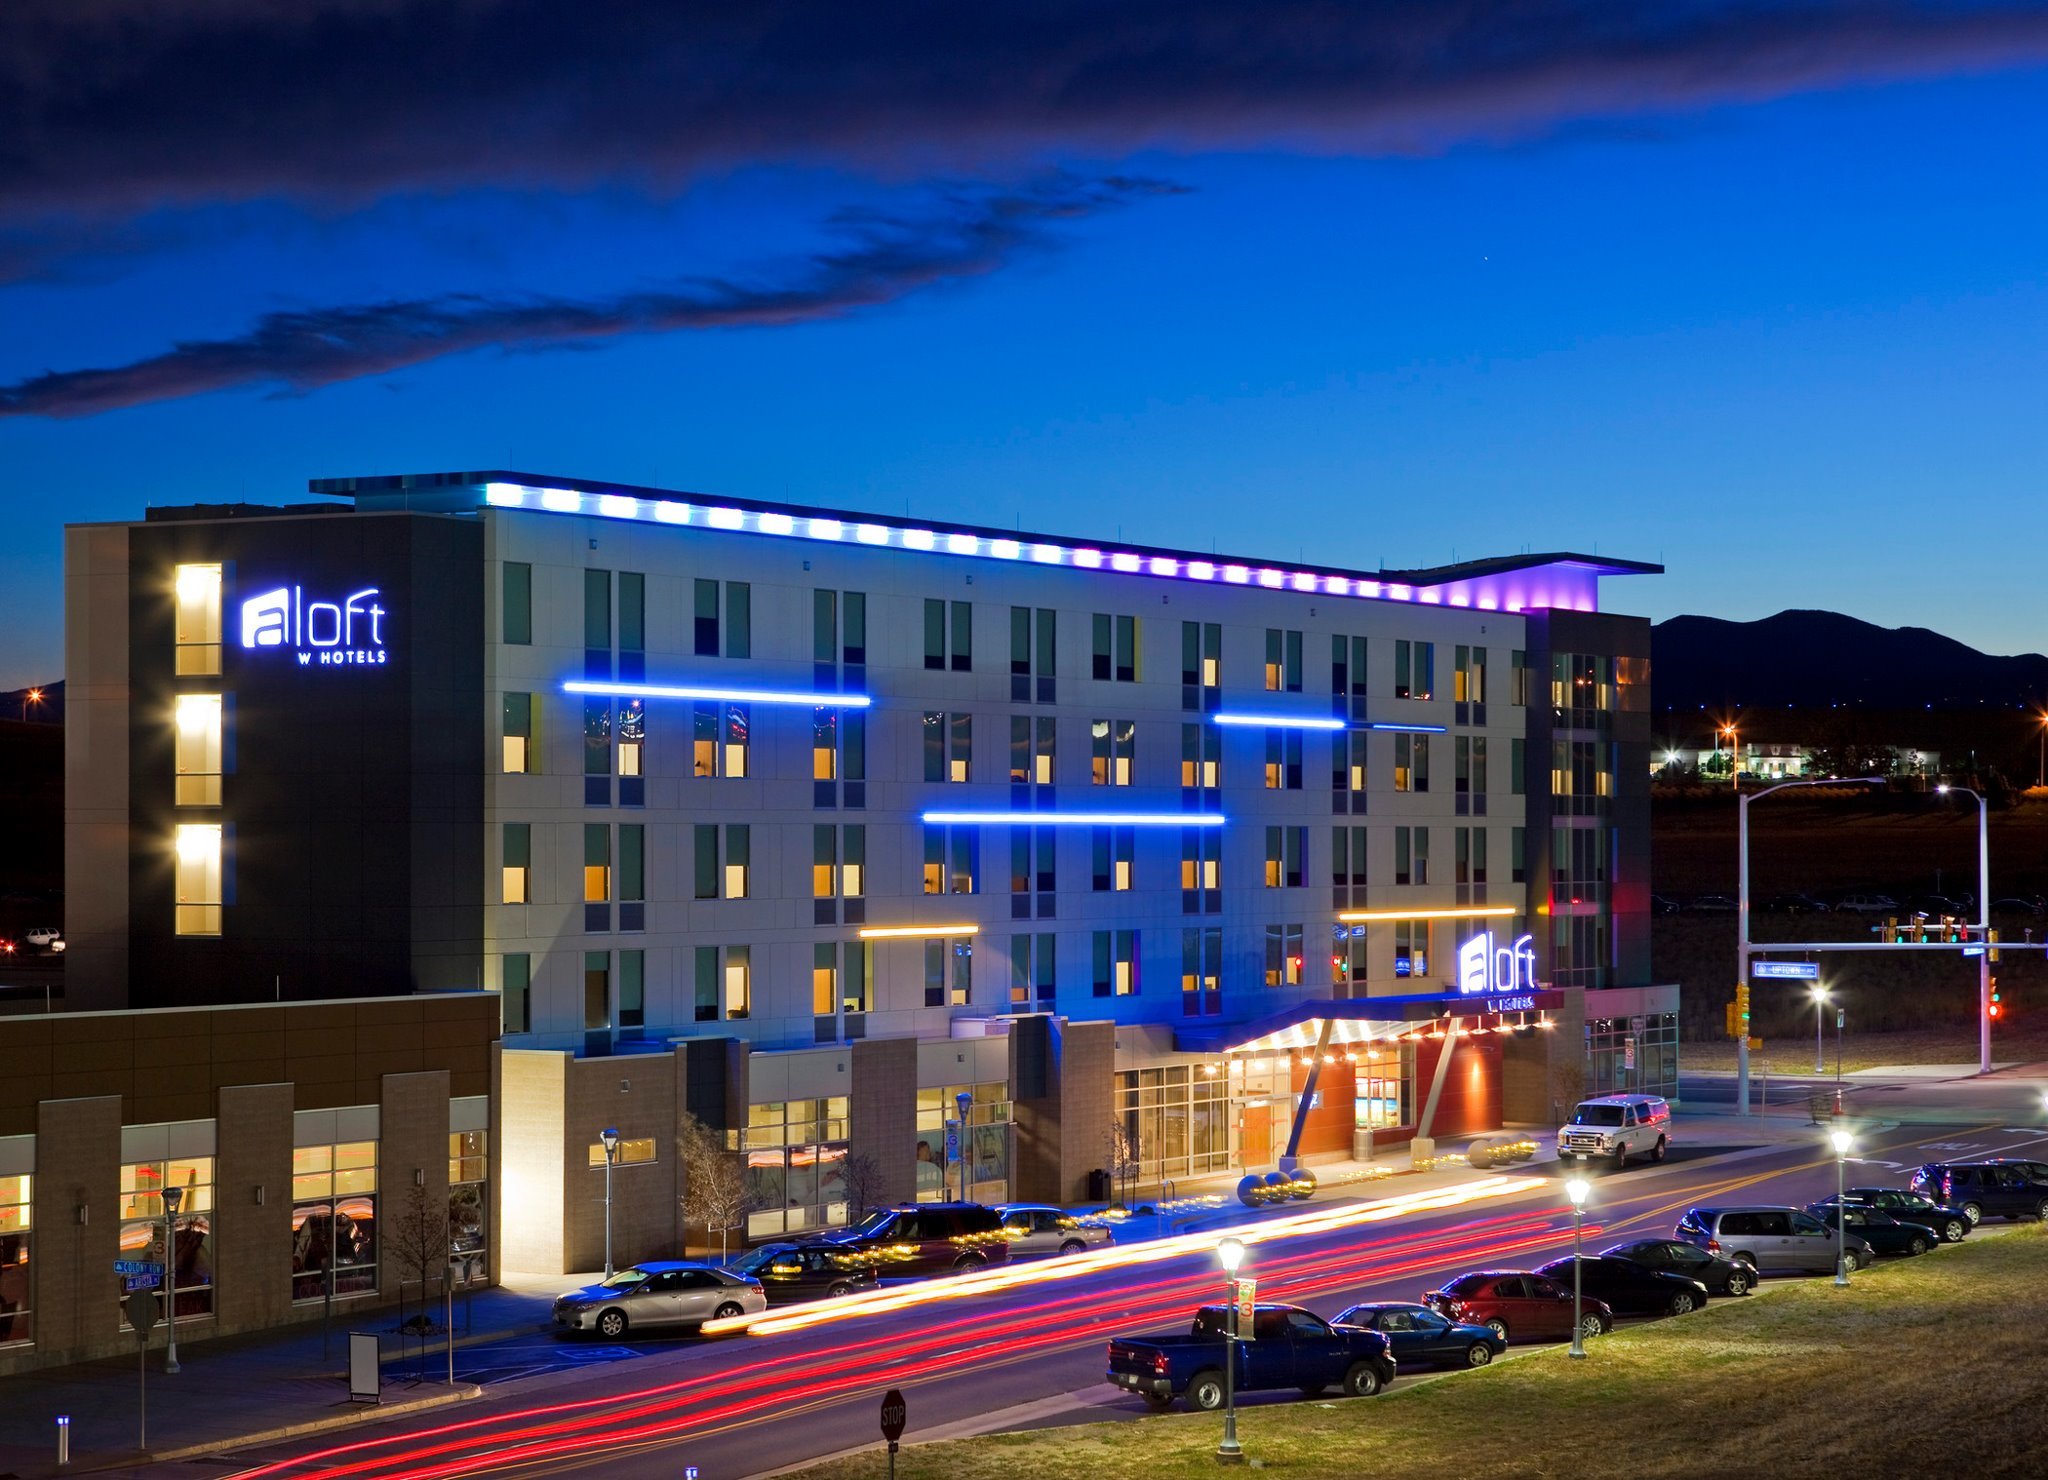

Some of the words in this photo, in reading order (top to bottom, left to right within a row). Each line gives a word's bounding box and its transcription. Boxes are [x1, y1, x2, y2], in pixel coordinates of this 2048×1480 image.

[242, 585, 385, 648] aloft
[298, 652, 311, 665] W
[321, 651, 386, 664] HOTELS
[1460, 931, 1535, 994] aloft
[153, 1242, 165, 1255] 3
[123, 1262, 147, 1273] COLONY
[1240, 1302, 1253, 1317] 3
[882, 1405, 904, 1426] STOP
